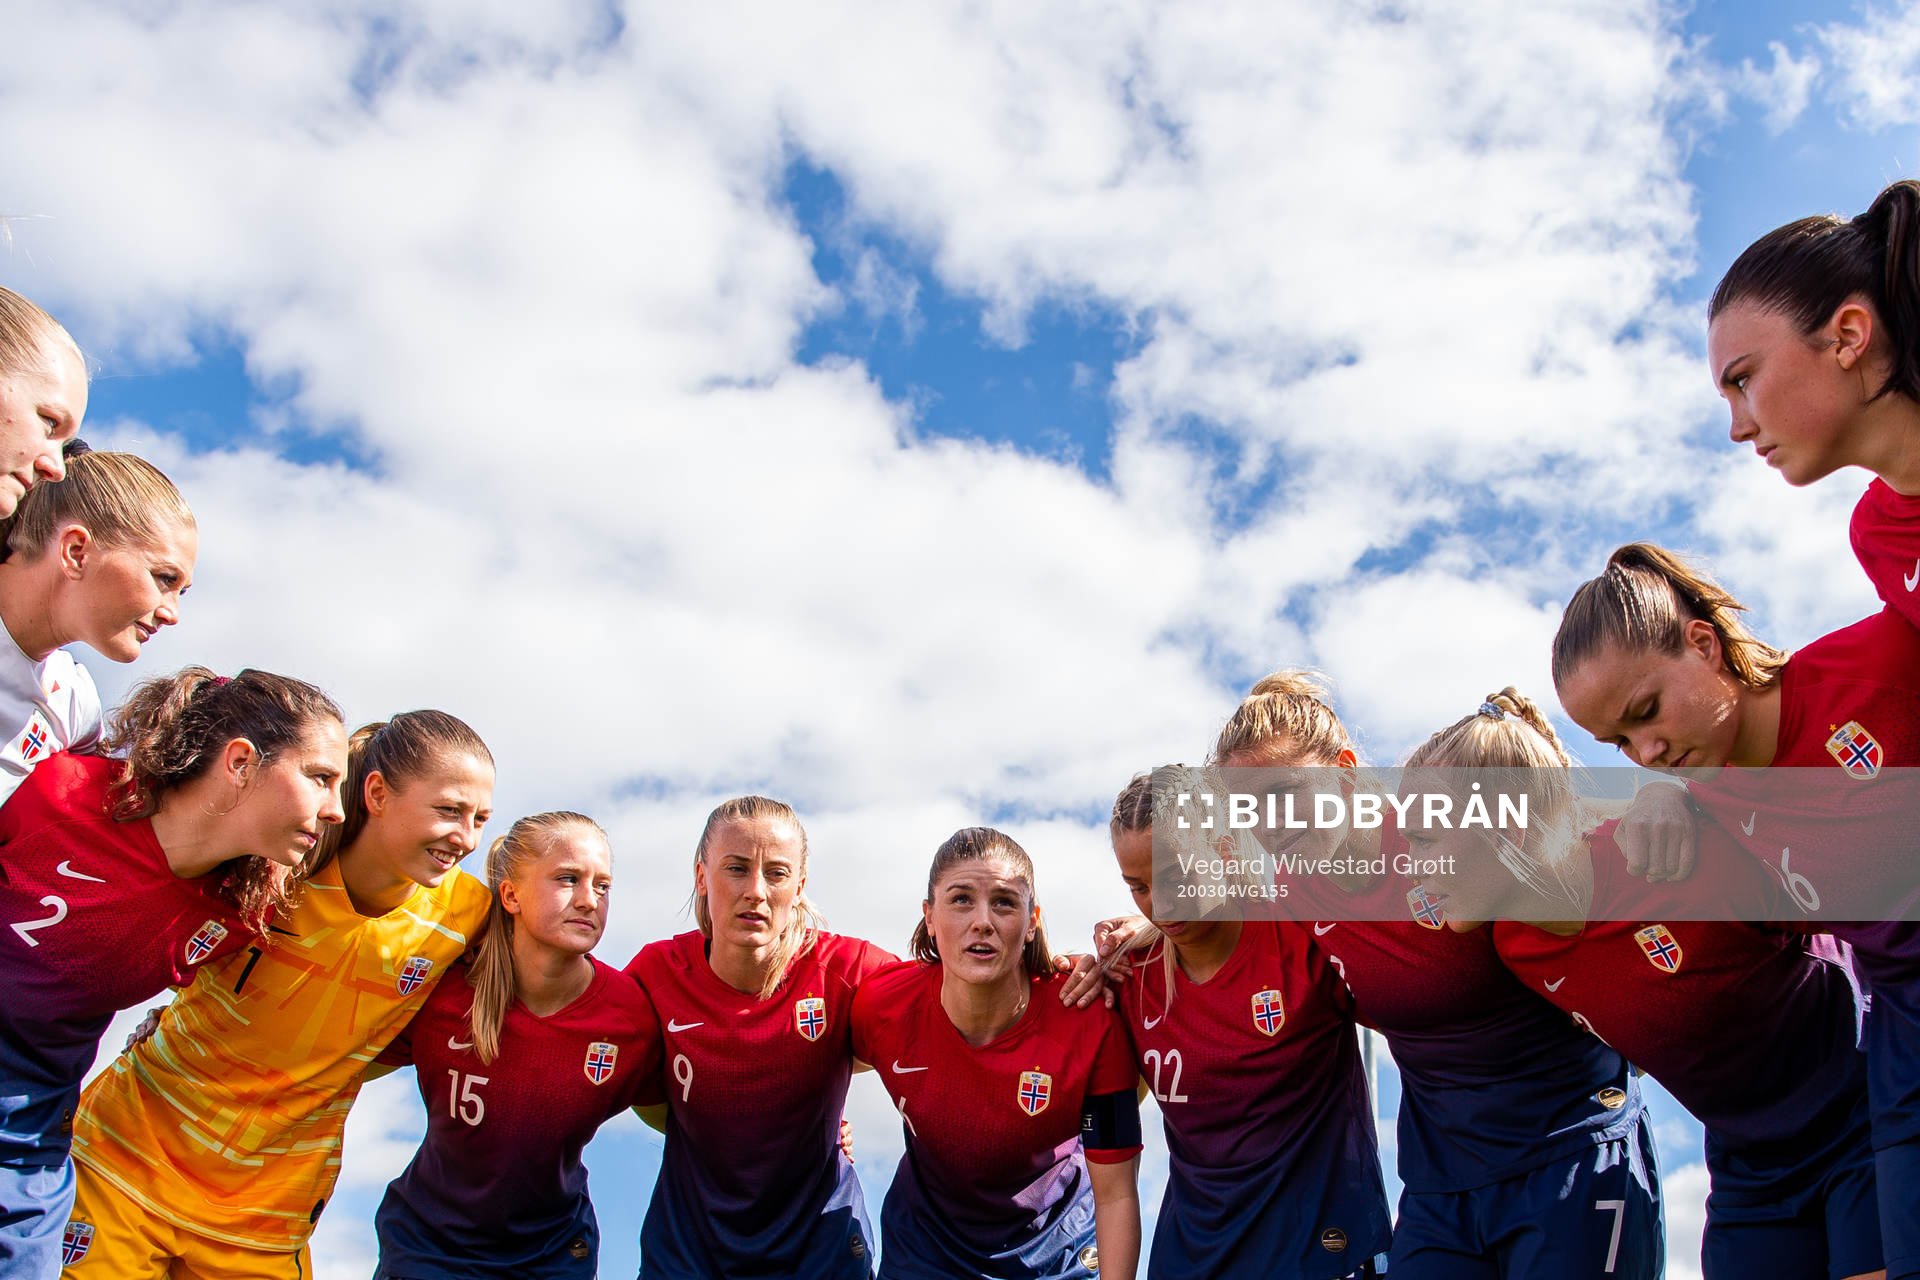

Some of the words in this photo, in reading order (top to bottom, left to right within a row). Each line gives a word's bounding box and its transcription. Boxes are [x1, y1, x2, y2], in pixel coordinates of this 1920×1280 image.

[10, 895, 67, 947] 2
[234, 946, 263, 995] 1
[448, 1068, 489, 1126] 15
[673, 1054, 698, 1102] 9
[1144, 1049, 1188, 1103] 22
[1595, 1200, 1625, 1273] 7
